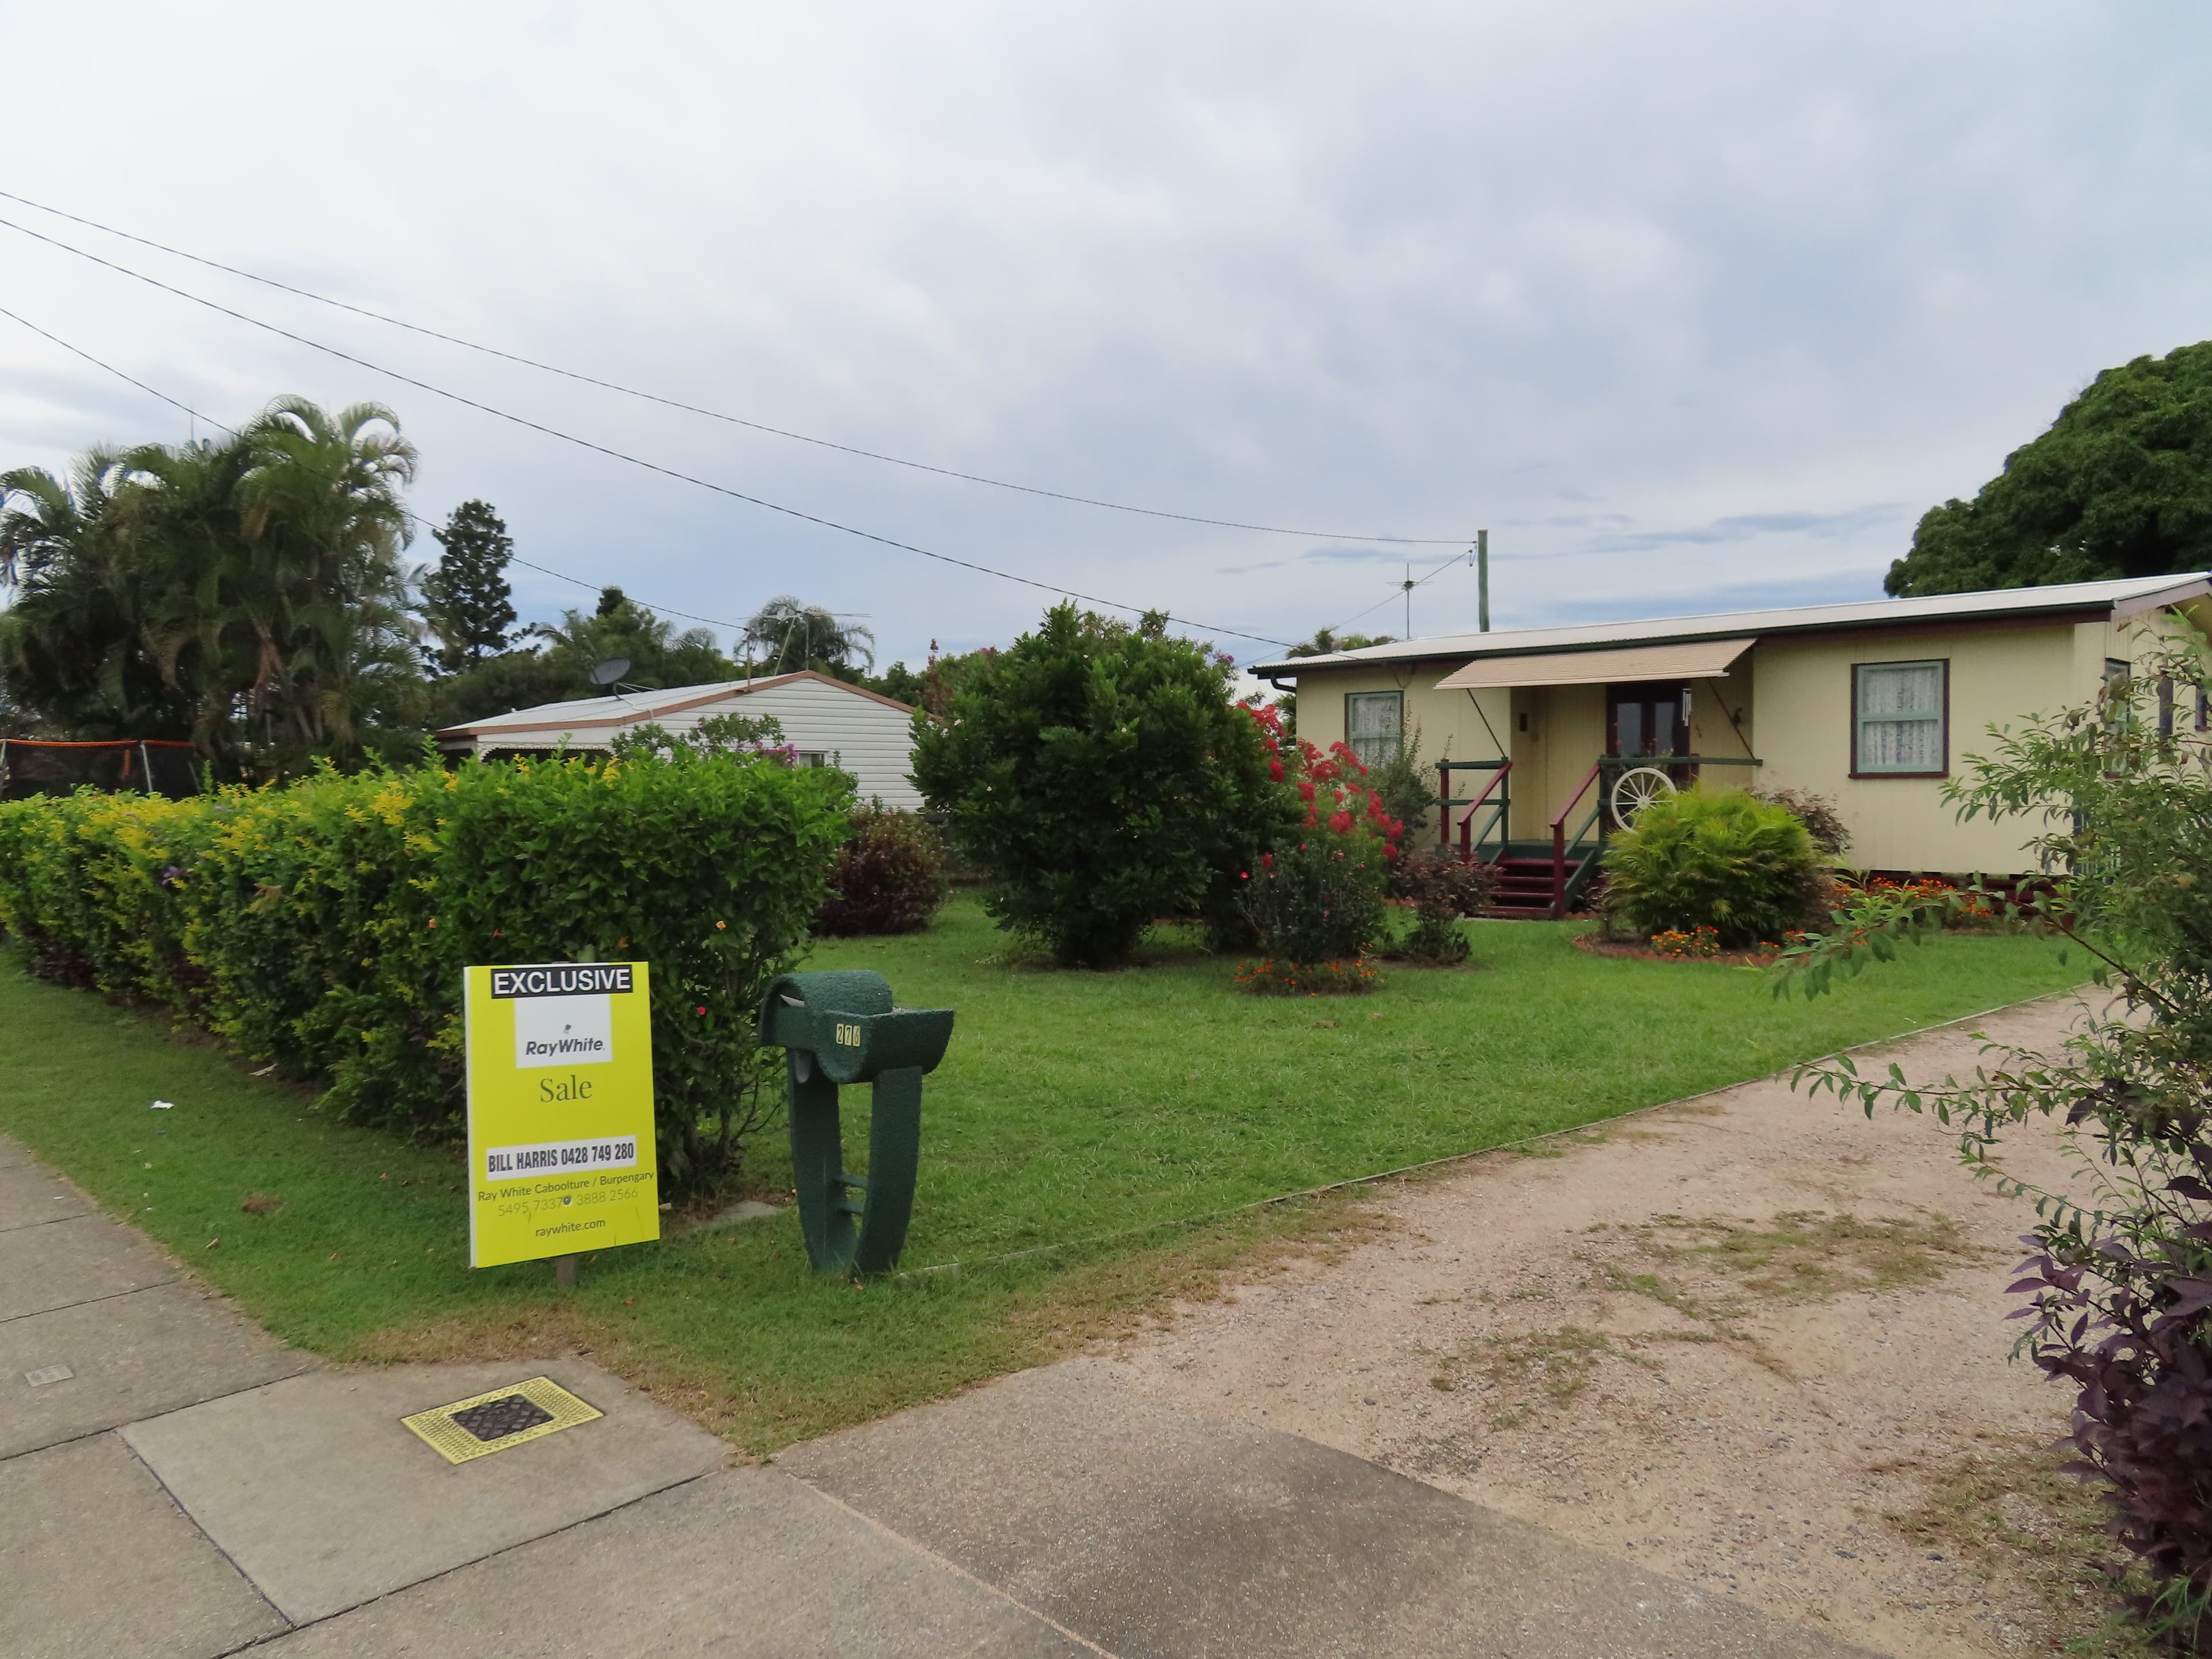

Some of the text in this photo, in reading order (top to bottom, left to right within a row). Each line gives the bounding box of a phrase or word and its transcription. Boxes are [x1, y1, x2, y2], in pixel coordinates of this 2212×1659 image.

[494, 968, 630, 994] EXCLUSIVE
[838, 1026, 859, 1044] 276
[540, 1074, 592, 1103] Sale
[488, 1142, 634, 1172] BILL HARRIS 0428 749 280
[478, 1191, 497, 1201] Ray
[500, 1186, 532, 1198] White
[535, 1180, 589, 1194] Caboolture
[600, 1172, 654, 1185] Burpengary
[498, 1187, 638, 1217] 5495 7337 3888 2566
[535, 1219, 605, 1237] raywhite.com
